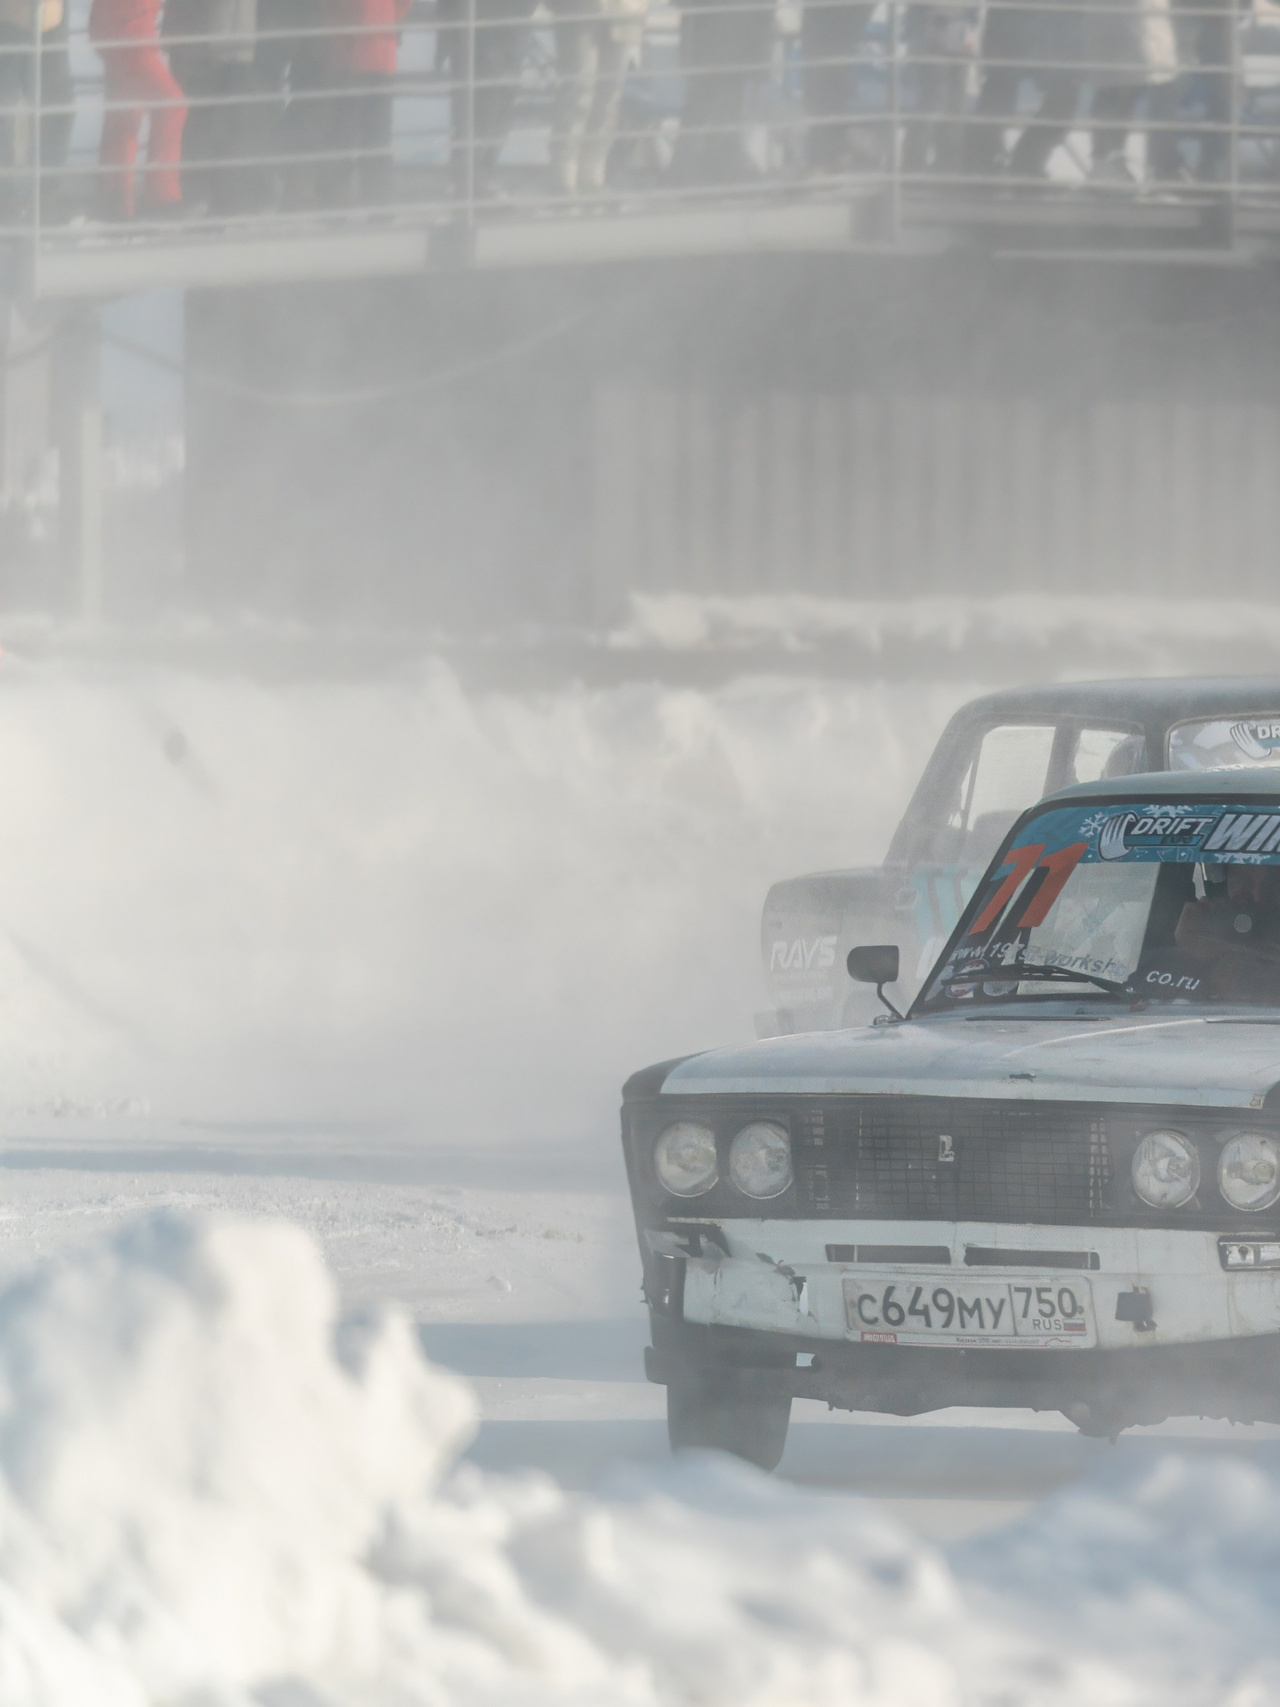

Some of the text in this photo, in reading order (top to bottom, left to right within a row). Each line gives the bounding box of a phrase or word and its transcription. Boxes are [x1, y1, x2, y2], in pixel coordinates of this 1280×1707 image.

[1130, 817, 1214, 835] DRIFT
[770, 935, 838, 971] RAYS
[1014, 1287, 1078, 1319] 750
[1032, 1318, 1062, 1331] RUS
